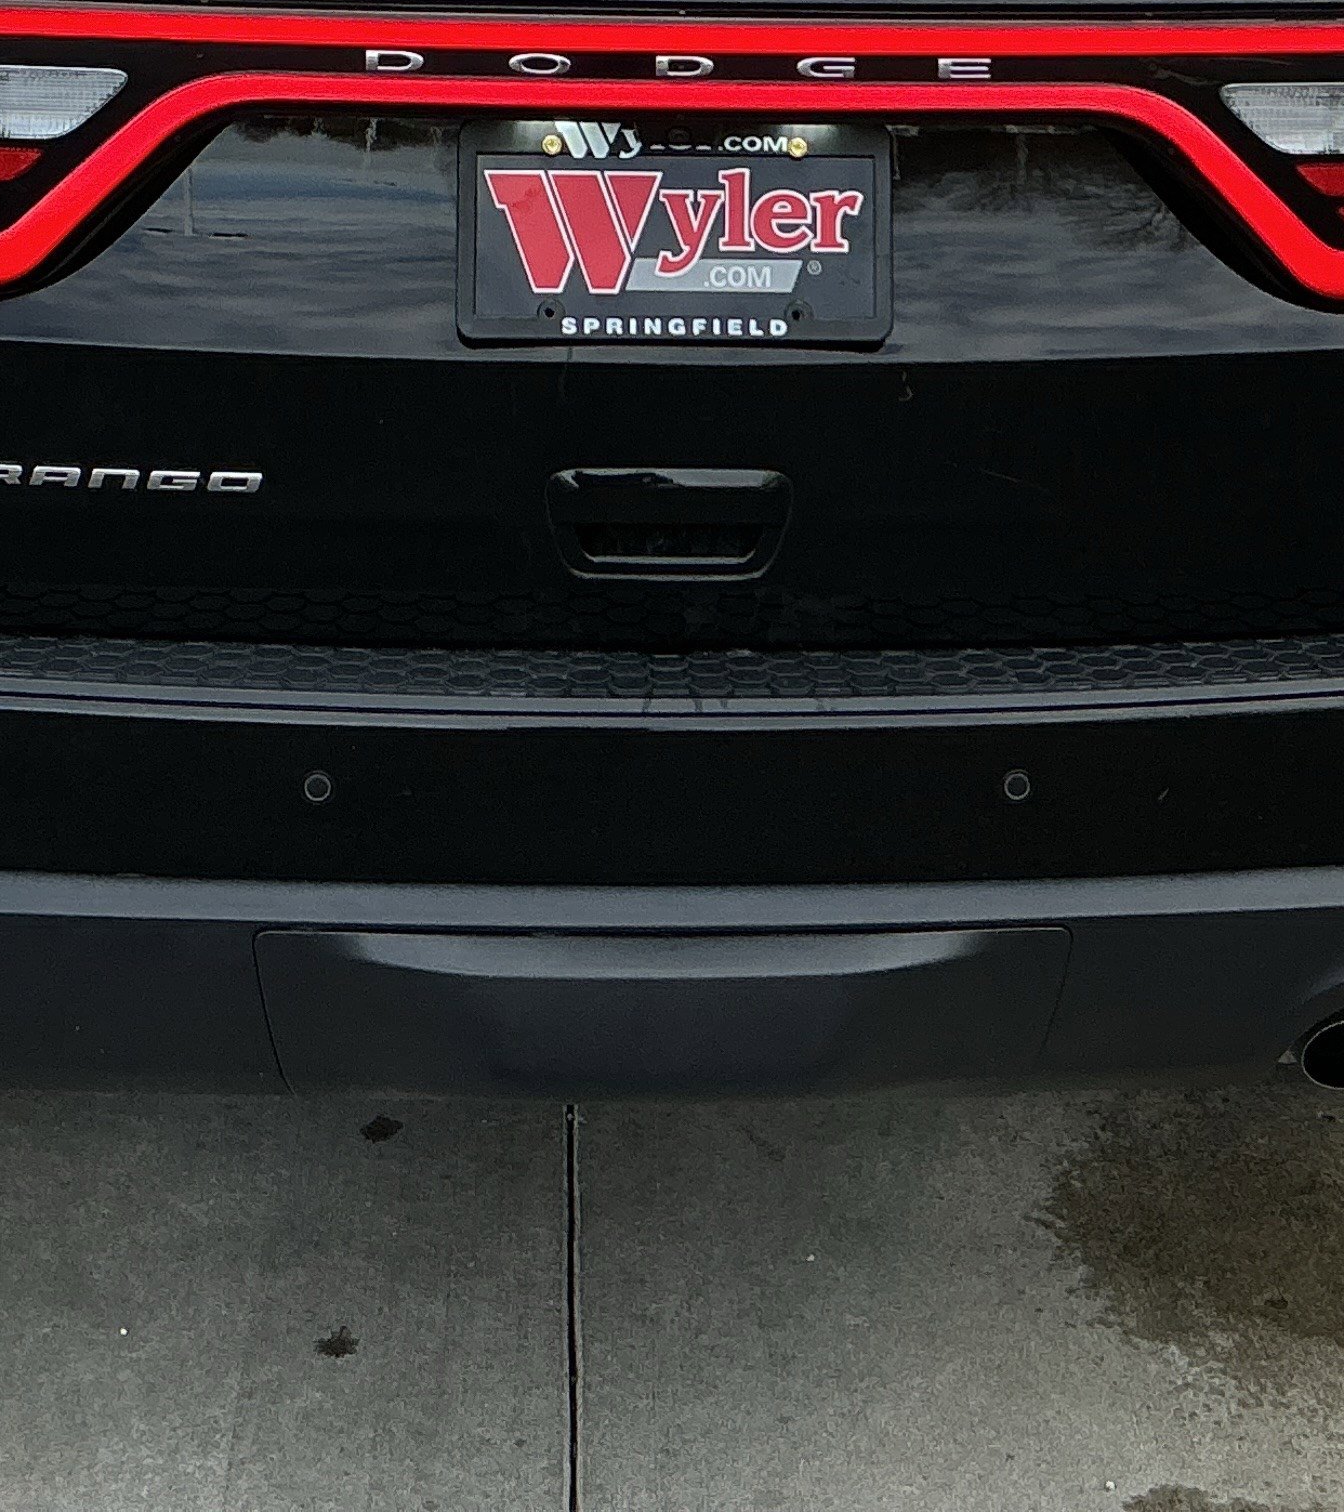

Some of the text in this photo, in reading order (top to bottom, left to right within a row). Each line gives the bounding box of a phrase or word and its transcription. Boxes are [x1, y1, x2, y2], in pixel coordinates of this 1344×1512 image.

[365, 50, 992, 79] DODGE
[554, 121, 787, 159] Wy.COM
[483, 167, 862, 295] Wyler
[704, 265, 772, 288] .COM
[561, 317, 789, 336] SPRINGFIELD
